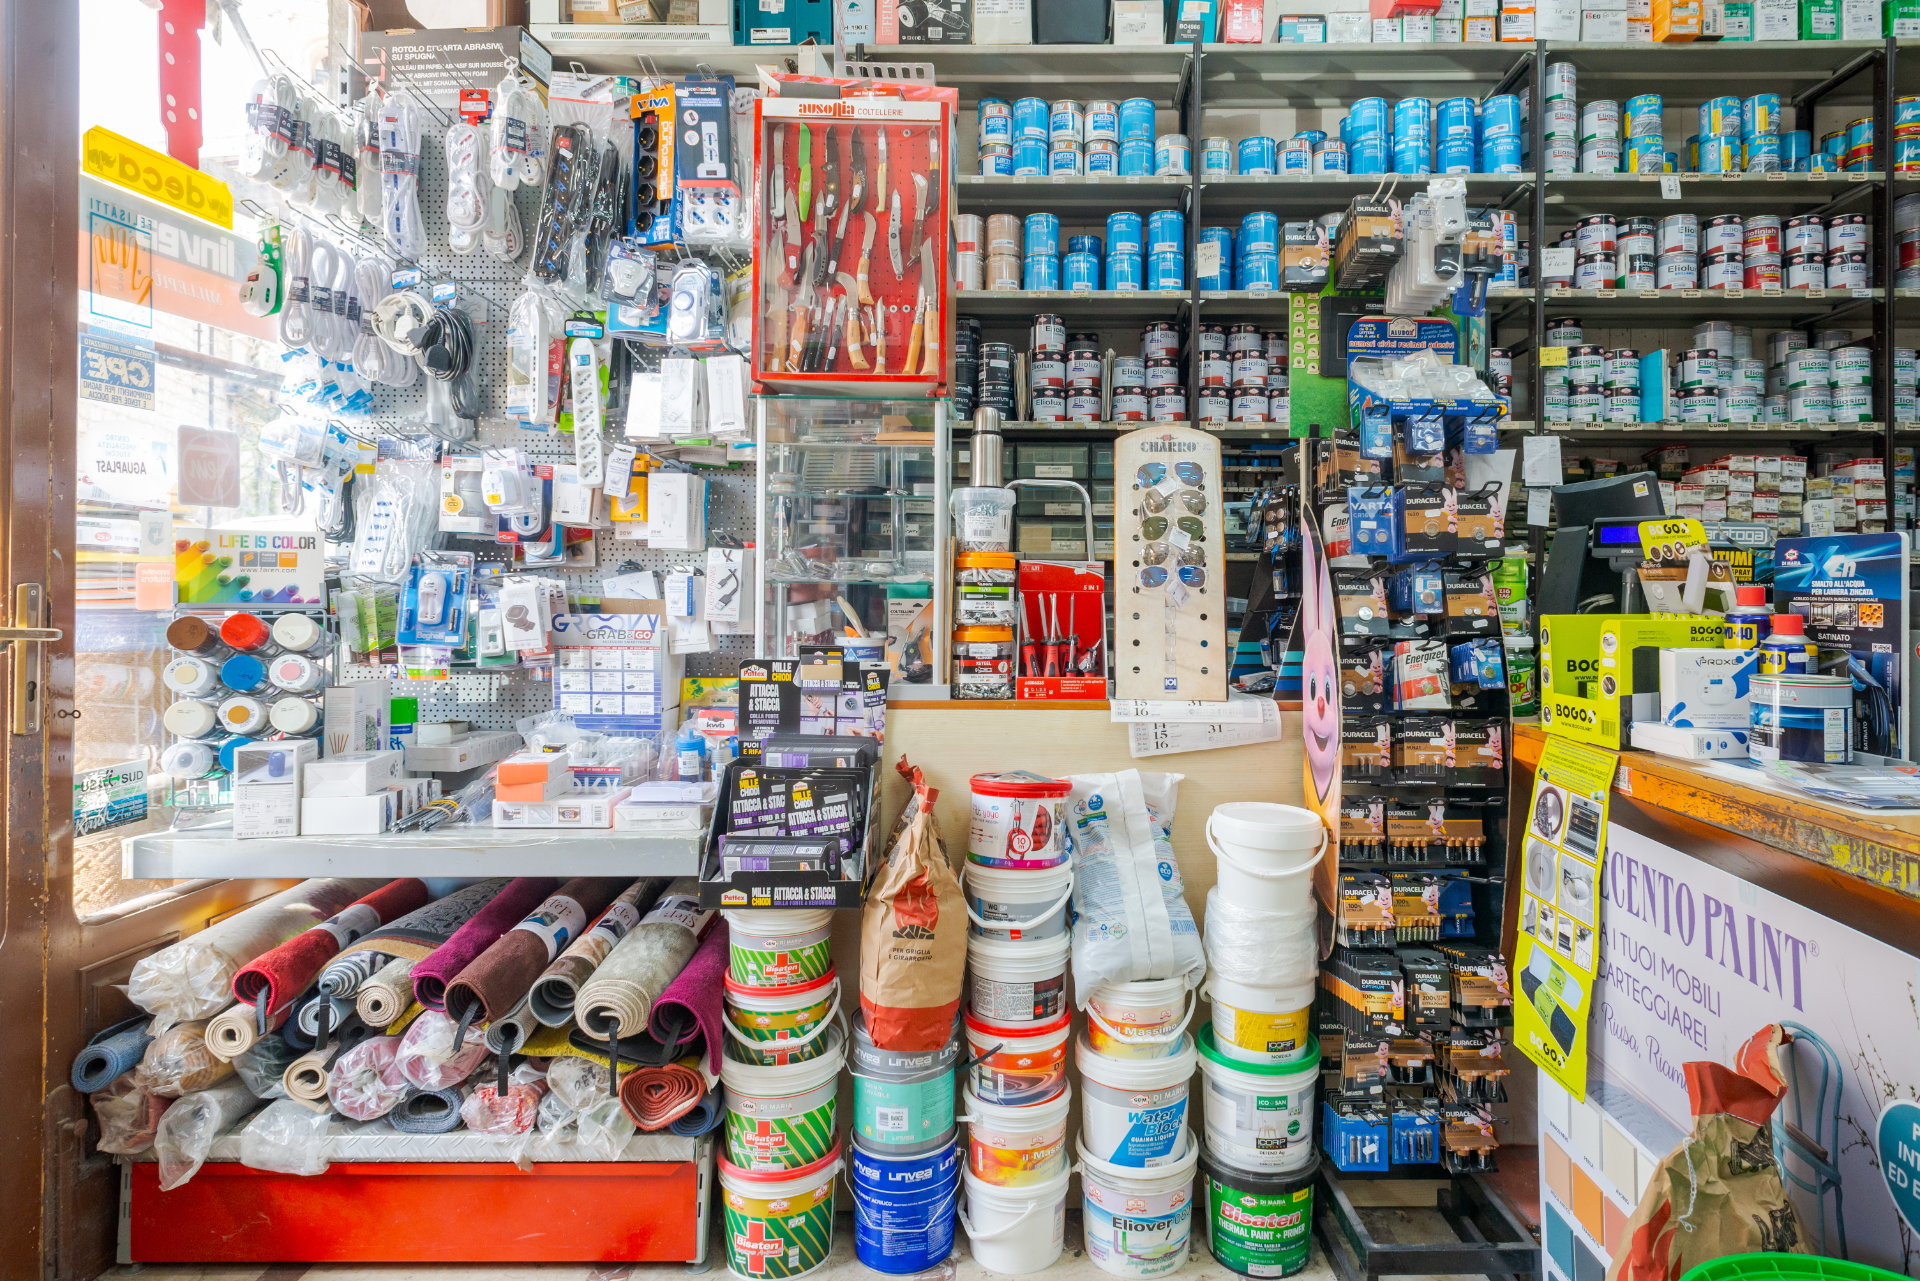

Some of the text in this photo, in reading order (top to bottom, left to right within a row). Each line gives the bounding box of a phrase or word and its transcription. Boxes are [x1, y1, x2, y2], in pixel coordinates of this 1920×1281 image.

[1233, 2, 1243, 31] FLEX
[391, 45, 425, 54] ROTOLO
[463, 42, 504, 51] ABRASIVA
[391, 52, 437, 61] SU SPUGNA
[480, 61, 504, 69] MOUSSE
[1635, 97, 1661, 106] ALCEA
[857, 108, 904, 116] COLTELLERIE
[1755, 137, 1780, 146] ALCEA
[1580, 226, 1610, 236] Eliolux
[1583, 264, 1613, 272] Eliolux
[1390, 329, 1415, 337] ALUBOX
[1349, 340, 1376, 348] numeri
[1377, 340, 1397, 348] civici
[1428, 341, 1455, 349] adesivi
[1569, 358, 1601, 367] Eliosint
[1035, 398, 1063, 407] Eliolux
[1683, 397, 1718, 406] Eliosint
[1831, 397, 1867, 406] Eliosint
[1140, 441, 1197, 453] CHARRO
[1350, 502, 1394, 510] VARTA
[1406, 497, 1442, 505] DURACELL
[219, 533, 317, 550] LIFE IS COLOR
[1811, 580, 1865, 588] SMALTO ALL'ACQUA
[1811, 588, 1874, 596] PER LAMIERA ZINCATA
[1817, 632, 1851, 642] SATINATO
[1405, 650, 1445, 665] Energizer
[771, 661, 792, 673] MILLE
[771, 672, 792, 682] CHIODI
[749, 683, 779, 698] ATTACCA
[754, 698, 781, 711] STACCA
[1134, 707, 1149, 717] 16
[705, 720, 726, 729] kwb
[1207, 724, 1223, 734] 31
[1153, 730, 1168, 740] 15
[1154, 740, 1169, 750] 16
[121, 770, 144, 784] SUD
[739, 778, 760, 789] MILLE
[740, 787, 760, 798] CHIODI
[792, 789, 812, 802] MILLE
[732, 797, 762, 814] ATTACCA
[794, 799, 813, 810] CHIODI
[788, 804, 848, 826] ATTACCA STACCA
[982, 810, 1000, 819] yoyo
[1016, 837, 1026, 845] 10
[751, 887, 771, 898] MILLE
[773, 887, 803, 900] ATTACCA
[804, 888, 810, 900] &
[810, 886, 836, 900] STACCA
[751, 897, 771, 906] CHIODI
[1599, 846, 1808, 1014] ECENTO PAINT
[904, 947, 931, 956] GRIGLIA
[893, 953, 933, 962] GIRARROSTO
[765, 963, 798, 973] Bisaten
[1599, 922, 1609, 947] A
[1619, 931, 1657, 976] TUOI
[1661, 956, 1721, 1018] MOBILI
[1430, 1008, 1436, 1016] 4
[1113, 1023, 1178, 1036] il Massimo
[1602, 1001, 1641, 1060] Riusa,
[1268, 1040, 1295, 1049] ICORP
[1451, 1039, 1484, 1047] DURACELL
[1153, 1085, 1185, 1102] DI MARIA
[760, 1101, 793, 1112] DI MARIA
[1127, 1108, 1175, 1124] Water
[1145, 1118, 1183, 1137] Block
[745, 1131, 784, 1144] Bisaten
[1130, 1131, 1175, 1143] GUAINA LIQUIDA
[1257, 1138, 1286, 1147] ICORP
[1022, 1152, 1029, 1161] il
[1888, 1163, 1909, 1188] ED
[871, 1197, 893, 1207] ACRILICO
[1220, 1201, 1302, 1229] Bisaten
[1112, 1215, 1173, 1232] Eliover
[1217, 1217, 1306, 1241] THERMAL PAINT PRIMER
[735, 1236, 779, 1252] Bisaten
